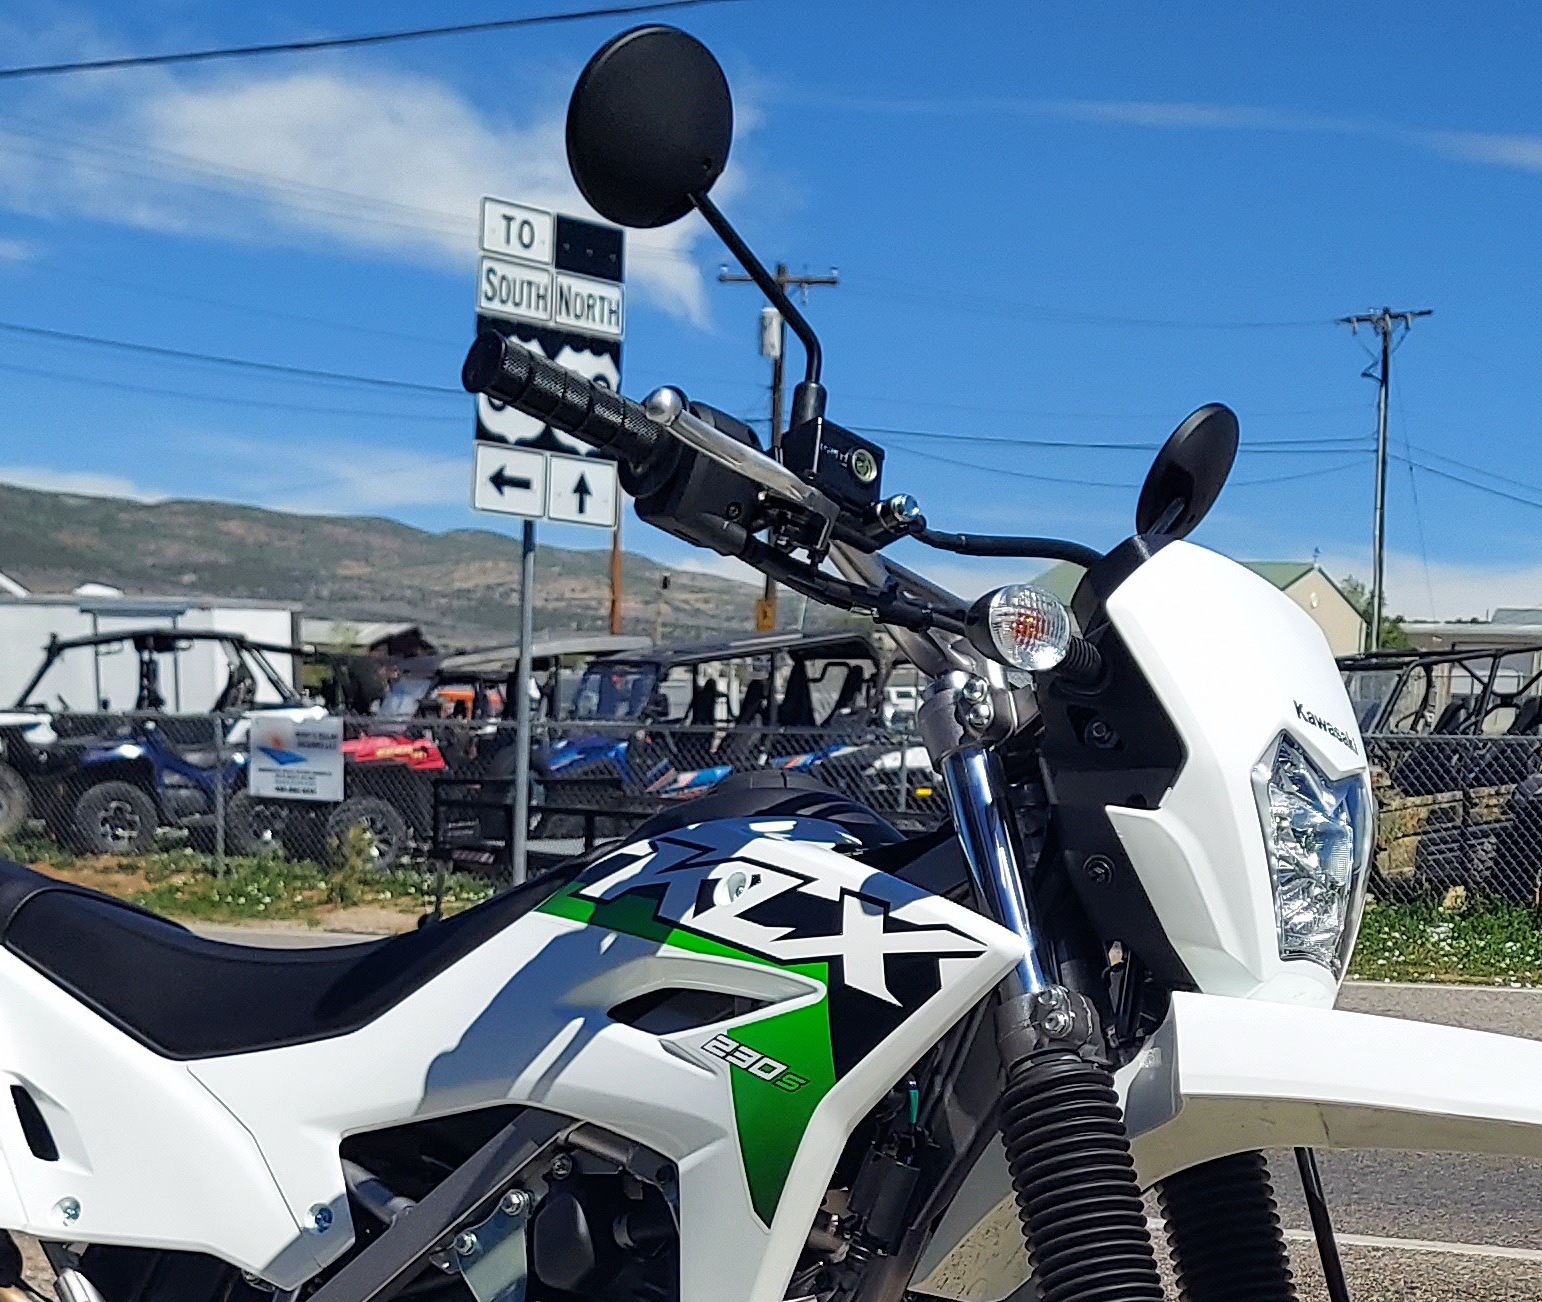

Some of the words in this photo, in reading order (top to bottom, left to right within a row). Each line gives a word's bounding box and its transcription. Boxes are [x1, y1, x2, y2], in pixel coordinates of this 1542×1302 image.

[501, 213, 536, 250] TO
[484, 266, 548, 313] SOUTH
[557, 281, 620, 329] NORTH
[1292, 699, 1359, 756] Kawasaki
